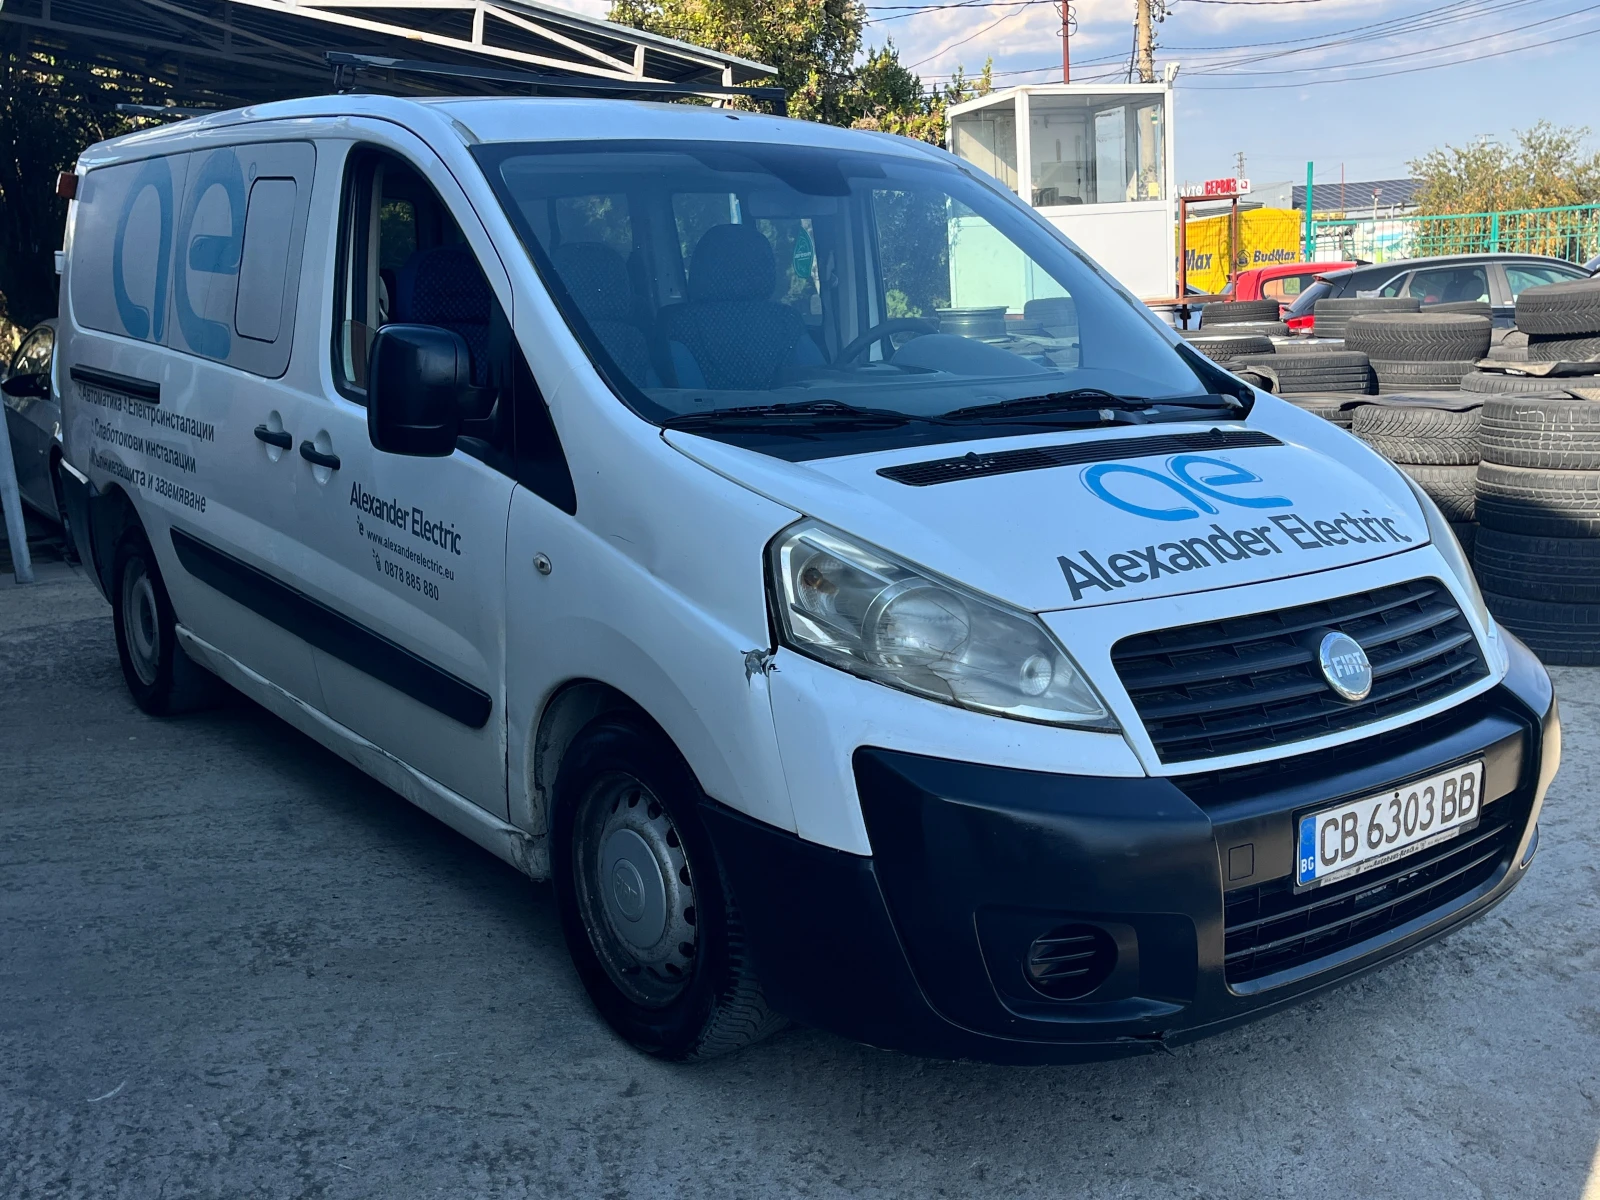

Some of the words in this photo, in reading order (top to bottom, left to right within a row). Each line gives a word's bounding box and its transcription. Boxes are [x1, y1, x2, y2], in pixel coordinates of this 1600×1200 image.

[1205, 178, 1237, 195] СЕРВИЗ
[1253, 248, 1296, 262] BudMax
[83, 386, 122, 411] Автоматика
[129, 398, 214, 442] Електроинсталации
[94, 418, 144, 454] Слаботокови
[145, 440, 197, 474] инсталации
[148, 473, 153, 490] и
[155, 477, 206, 514] заземяване
[350, 481, 409, 530] Alexander
[411, 507, 461, 555] Electric
[366, 529, 455, 581] www.alexanderelectric.eu
[1056, 524, 1283, 601] Alexander
[1268, 510, 1413, 550] Electric
[384, 560, 404, 582] 0878
[405, 570, 421, 592] 885
[423, 580, 439, 601] 880
[1331, 652, 1365, 678] FIAT
[1320, 811, 1358, 867] CB
[1366, 786, 1435, 850] 6303
[1440, 772, 1475, 824] BB
[1301, 856, 1315, 873] BG
